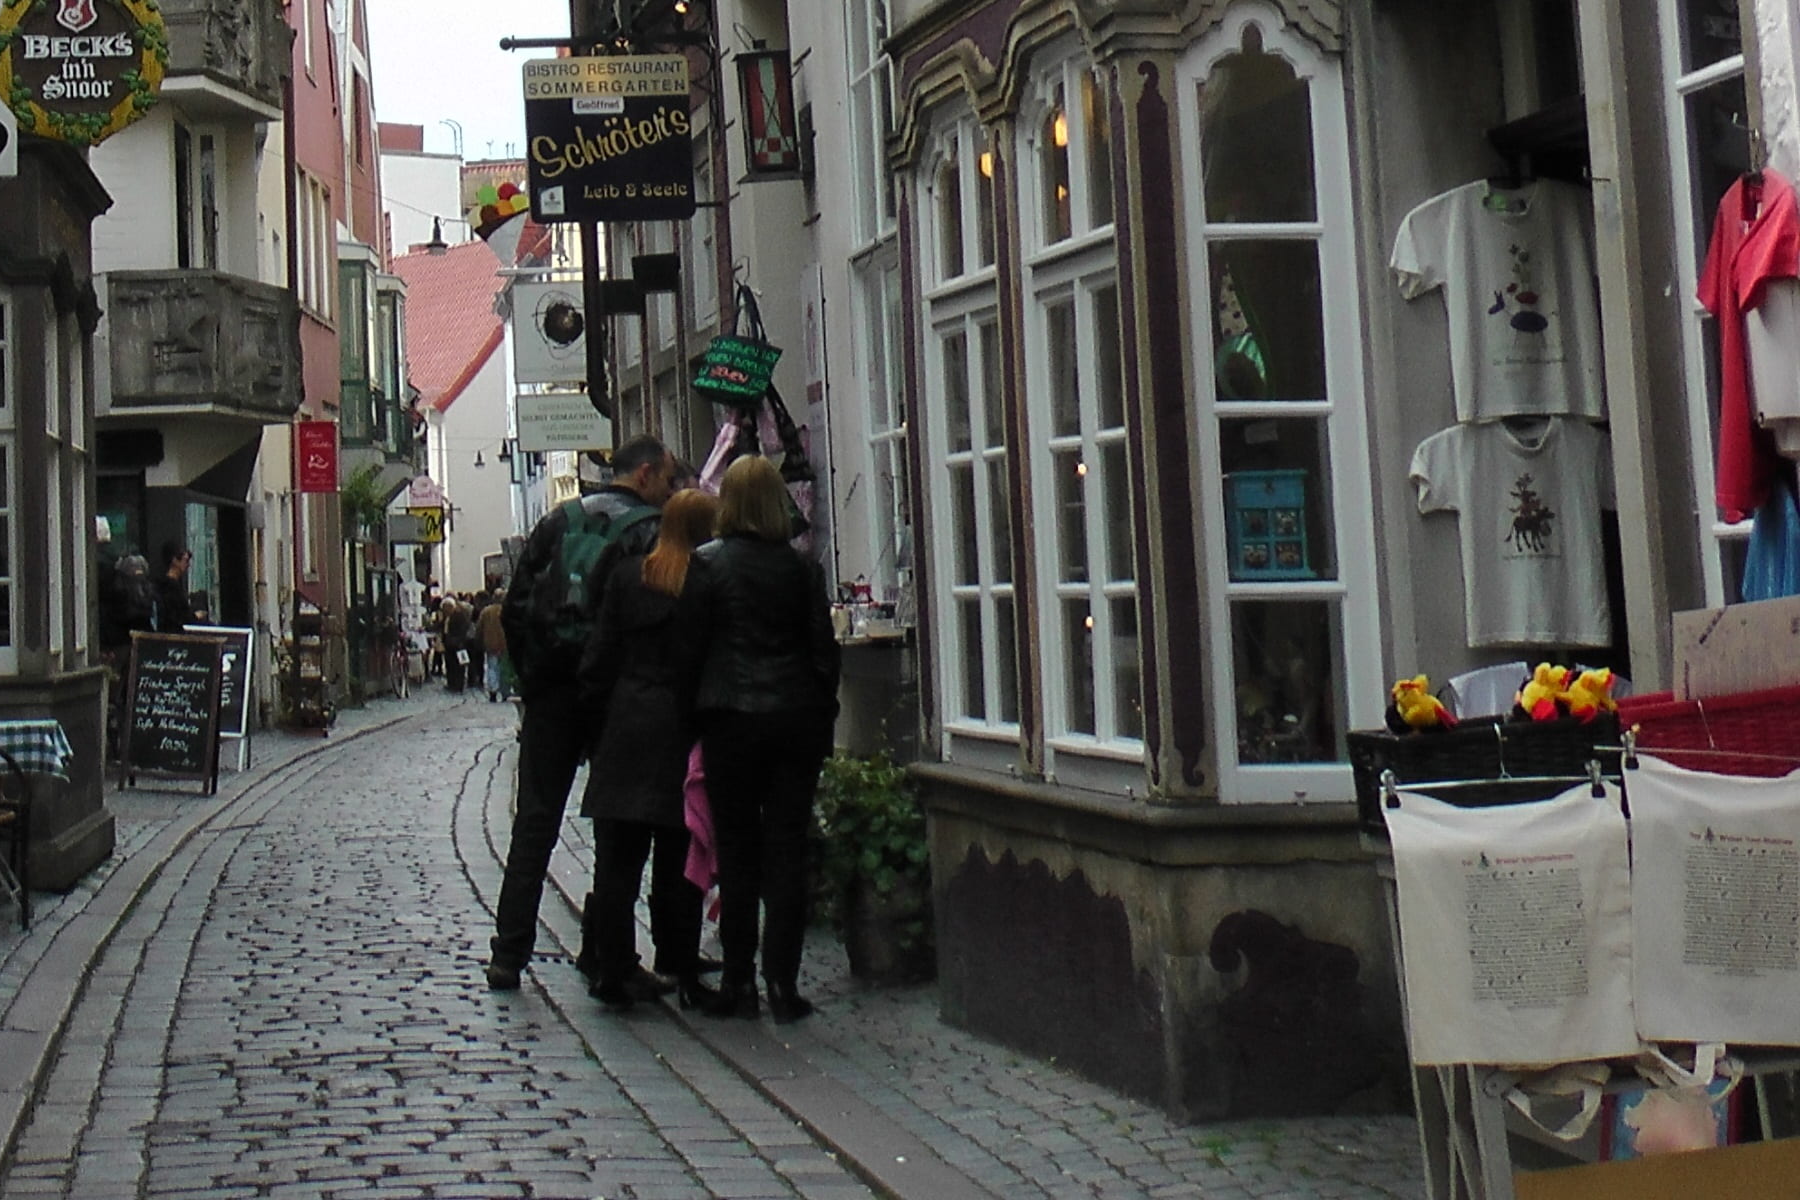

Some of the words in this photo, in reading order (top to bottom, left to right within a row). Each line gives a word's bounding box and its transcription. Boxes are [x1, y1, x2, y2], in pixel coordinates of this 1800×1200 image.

[527, 62, 580, 78] BISTRO
[587, 60, 683, 76] RESTAURANT
[42, 75, 114, 100] Snoor
[527, 79, 686, 95] SOMMERGARTEN
[531, 106, 690, 178] Schröter's
[583, 184, 620, 199] Leib
[642, 182, 688, 197] Seele
